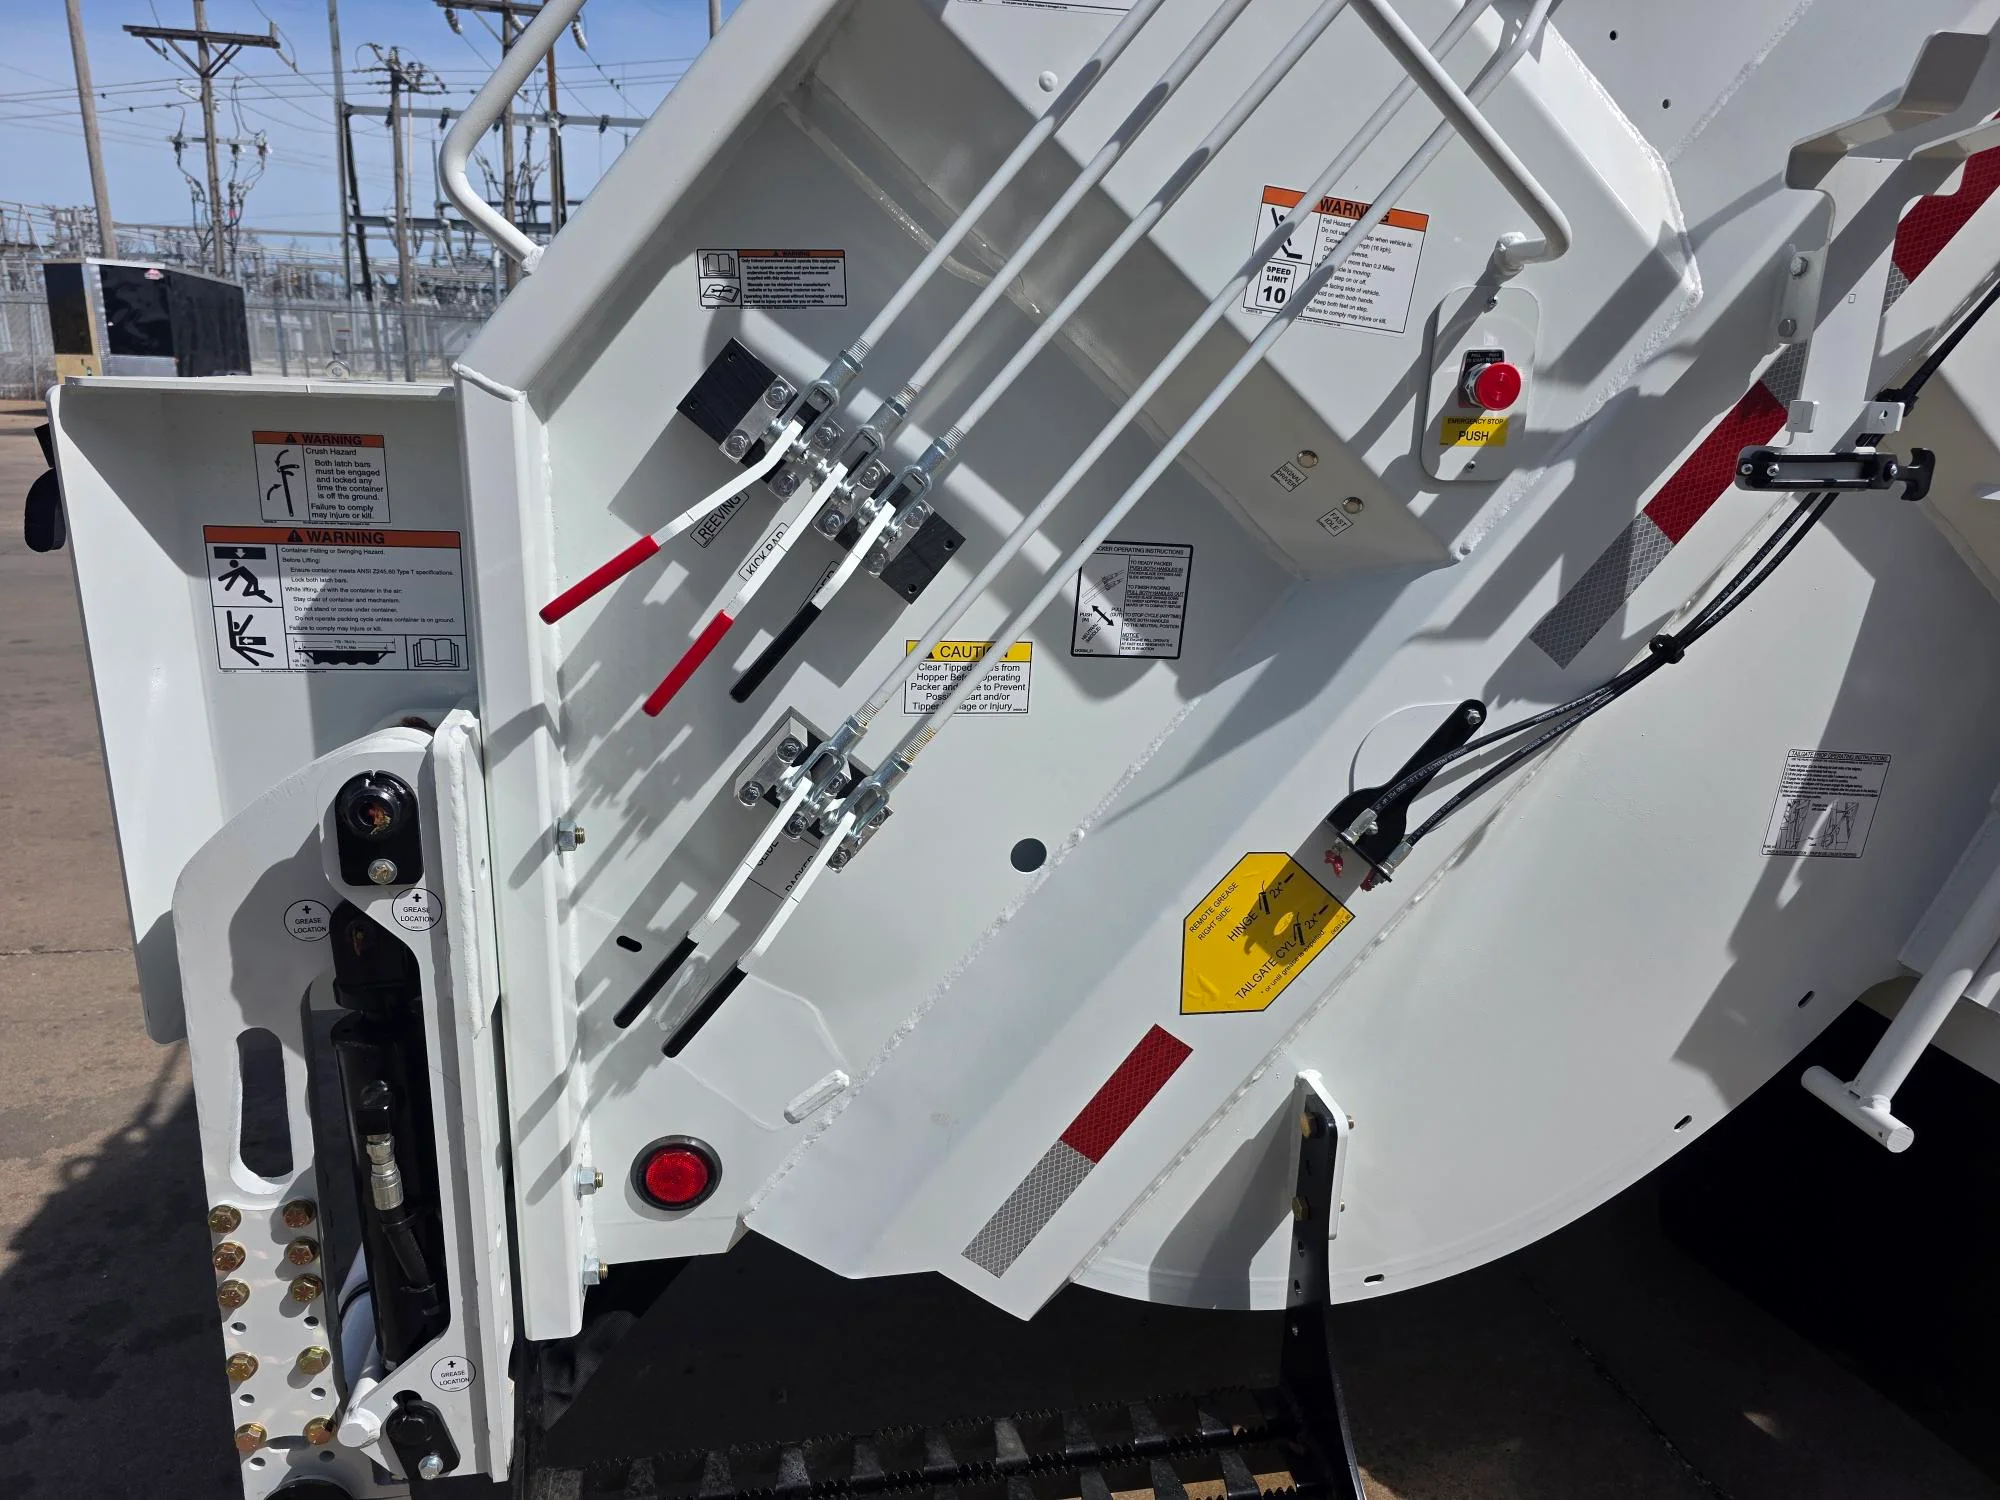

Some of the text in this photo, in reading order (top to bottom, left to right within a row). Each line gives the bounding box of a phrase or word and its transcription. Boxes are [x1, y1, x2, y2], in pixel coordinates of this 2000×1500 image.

[1266, 265, 1292, 276] SPEED
[1382, 264, 1396, 272] Miles
[1266, 274, 1288, 284] LIMIT
[1329, 283, 1344, 291] facing
[1263, 286, 1286, 304] 10
[1314, 298, 1326, 306] Keep
[1306, 305, 1322, 314] Failure
[1329, 310, 1346, 318] comply
[302, 434, 362, 445] WARNING
[1458, 431, 1489, 441] PUSH
[330, 448, 357, 456] Hazard
[315, 459, 332, 467] Both
[354, 460, 371, 468] bars
[347, 469, 380, 477] engaged
[1282, 465, 1301, 483] SIGNAL
[1276, 470, 1297, 488] DRIVER
[347, 504, 374, 512] comply
[698, 494, 742, 540] REEVING
[1330, 512, 1347, 527] FAST
[1324, 518, 1340, 532] IDLE
[306, 530, 385, 545] WARNING
[745, 552, 768, 576] KICK
[940, 645, 1008, 659] CAUTI
[918, 663, 1020, 673] Clear Tipped from
[916, 673, 948, 683] Hopper
[910, 683, 1026, 691] Packer and to Prevent
[984, 692, 1010, 701] and/or
[912, 702, 939, 712] Tipper
[989, 702, 1012, 712] Injury
[1189, 881, 1239, 933] REMOTE GREASE
[1197, 905, 1233, 941] RIGHT SIDE:
[1226, 911, 1258, 942] HINGE
[1265, 984, 1273, 993] or
[1271, 974, 1283, 988] until
[1281, 958, 1300, 976] grease
[1303, 930, 1325, 953] expelled
[1234, 956, 1278, 1000] TAILGATE
[1275, 939, 1296, 960] CYL
[440, 1370, 465, 1378] GREASE
[440, 1377, 470, 1386] LOCATION
